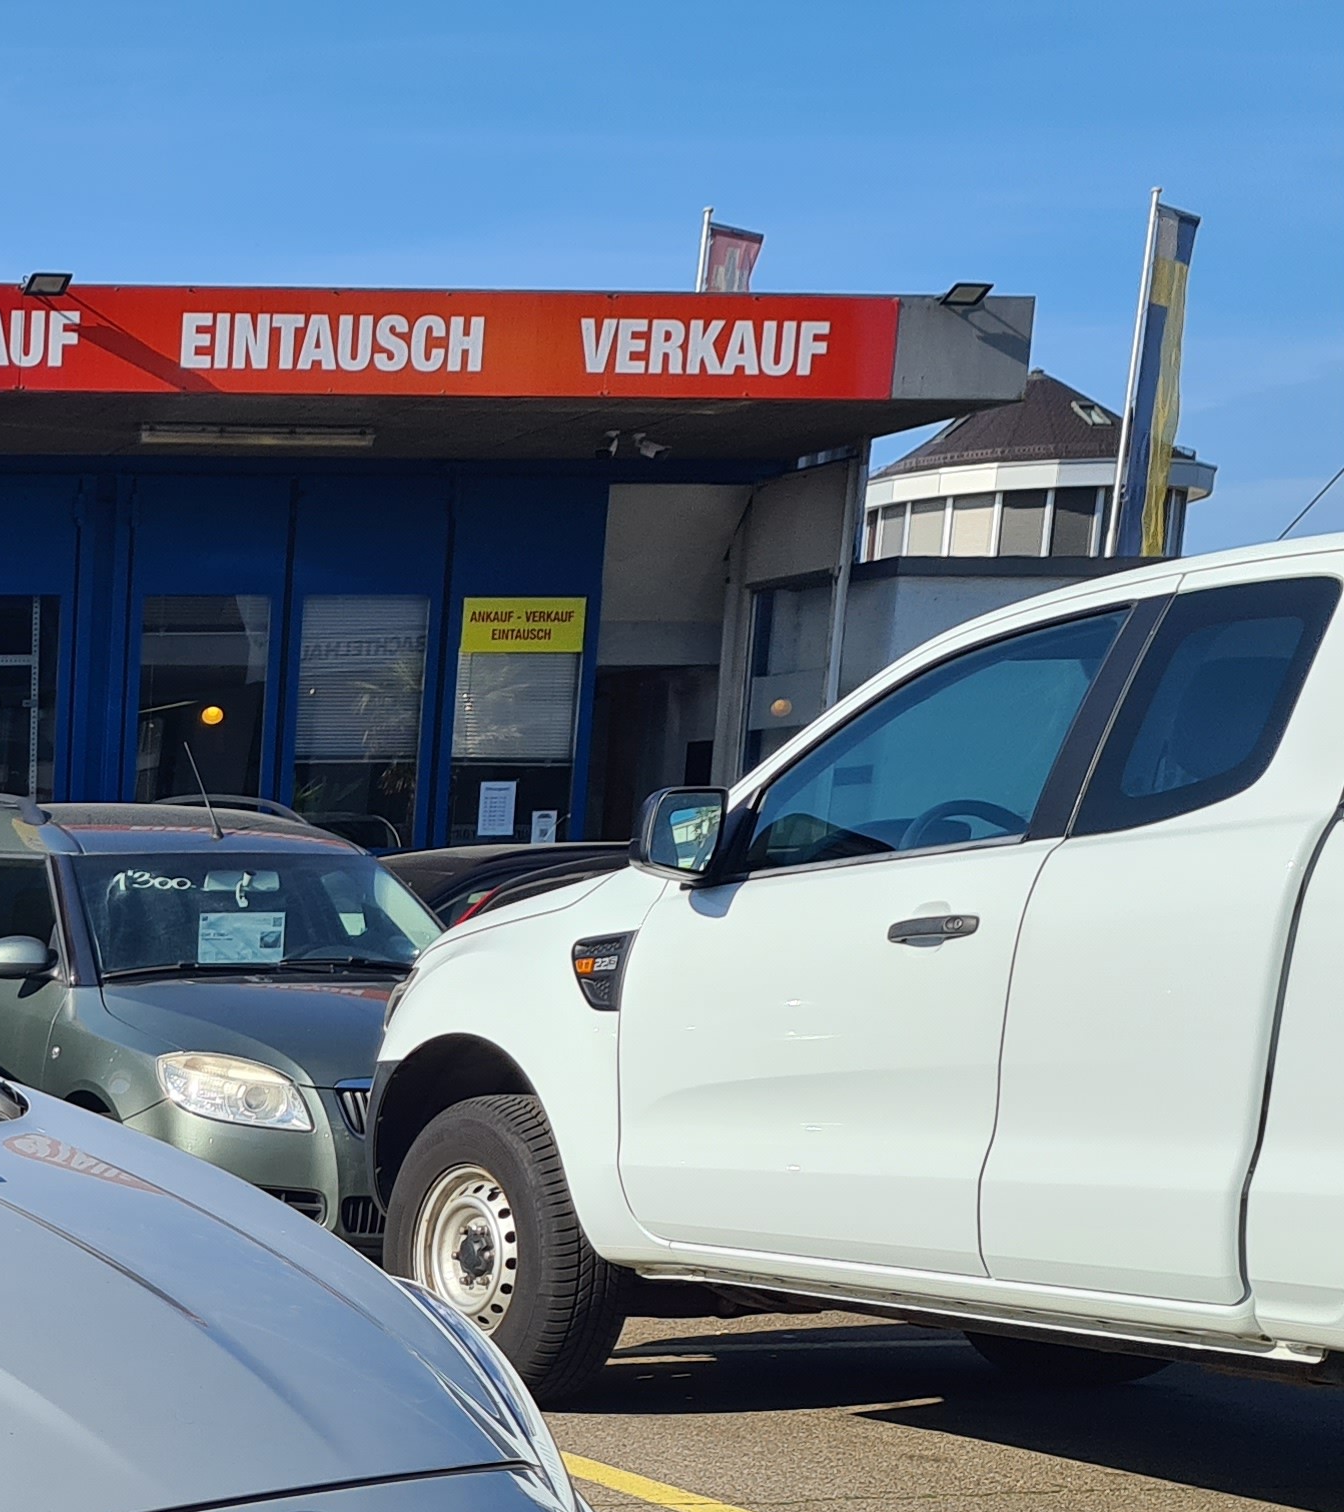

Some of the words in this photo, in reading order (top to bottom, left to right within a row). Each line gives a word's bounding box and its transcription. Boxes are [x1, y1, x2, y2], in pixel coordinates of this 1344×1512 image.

[179, 312, 485, 373] EINTAUSCH
[580, 315, 830, 377] VERKAUF
[470, 610, 515, 623] ANKAUF
[525, 610, 575, 623] VERKAUF
[491, 628, 552, 641] EINTAUSCH
